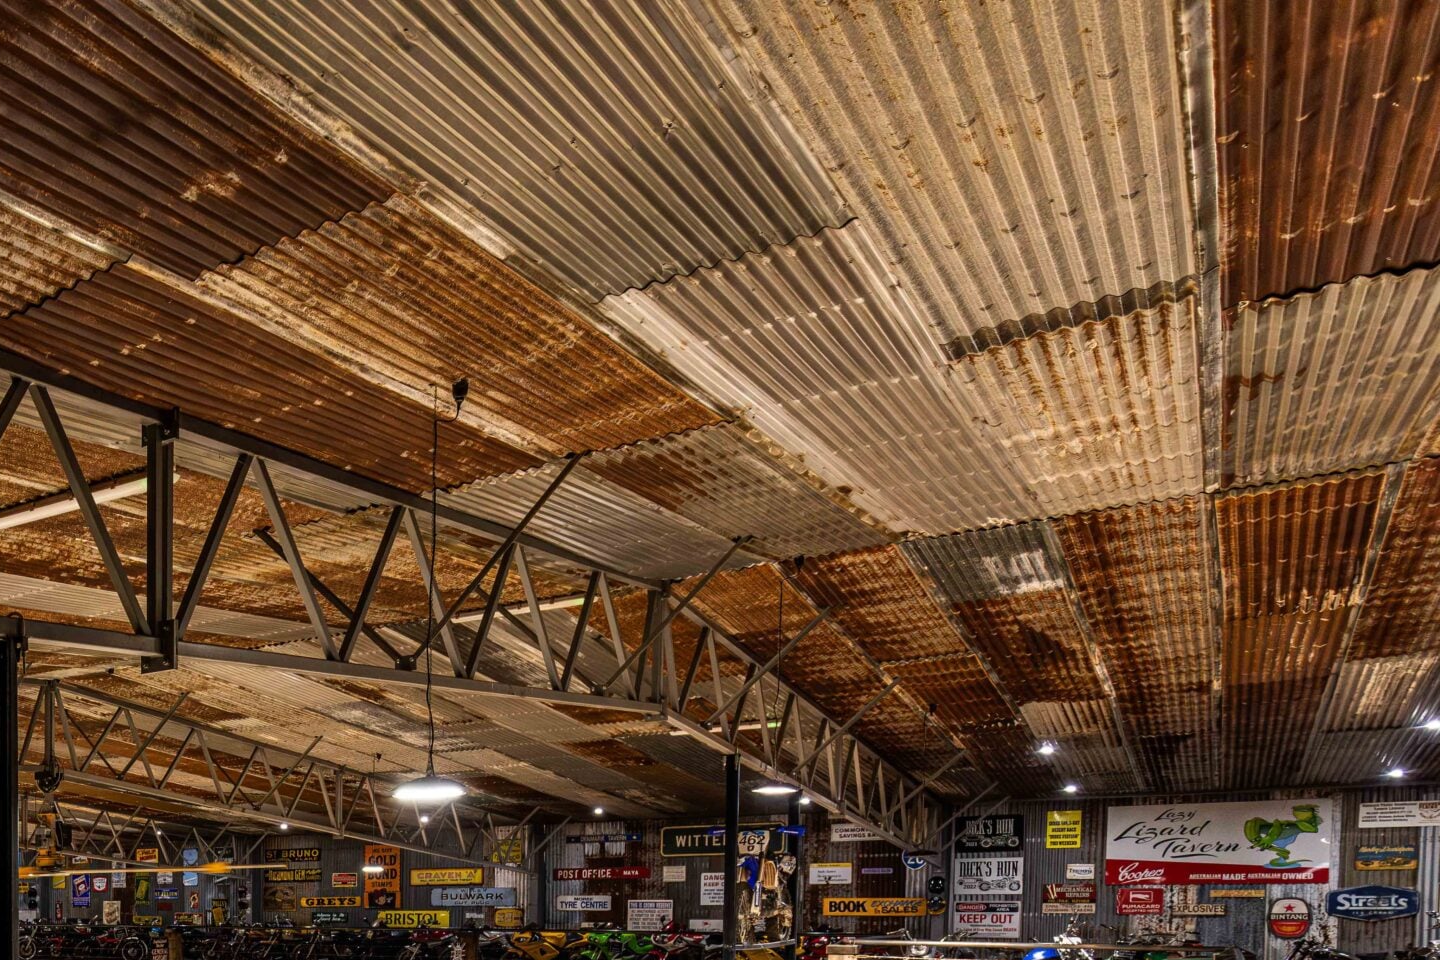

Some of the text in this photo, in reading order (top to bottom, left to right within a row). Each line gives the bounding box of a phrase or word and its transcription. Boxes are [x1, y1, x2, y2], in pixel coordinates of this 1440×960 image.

[1156, 808, 1198, 821] Lazy
[834, 827, 866, 835] COMMON
[996, 818, 1015, 834] RUN
[1114, 820, 1211, 844] Lizard
[738, 835, 764, 845] 462
[1154, 837, 1242, 858] Tavern
[281, 849, 319, 858] BRUNO
[368, 855, 396, 866] GOLD
[558, 870, 578, 878] POST
[582, 868, 611, 878] OFFICE
[959, 861, 1019, 877] DICK'S RUN
[1118, 862, 1165, 881] Coopers
[368, 869, 397, 880] BOND
[416, 871, 461, 879] CRAVEN
[1248, 872, 1281, 880] AUSTRALIAN
[1282, 872, 1314, 880] OWNED
[305, 897, 357, 906] GREYS
[440, 893, 503, 901] BULWARK
[560, 900, 609, 909] TYRE CENTRE
[828, 901, 868, 912] BOOK
[1336, 894, 1409, 911] Streets
[1173, 904, 1225, 914] EXPLOSIVES
[385, 913, 441, 926] BRISTOL
[959, 914, 1015, 924] KEEP OUT
[1270, 913, 1309, 921] BINTANG
